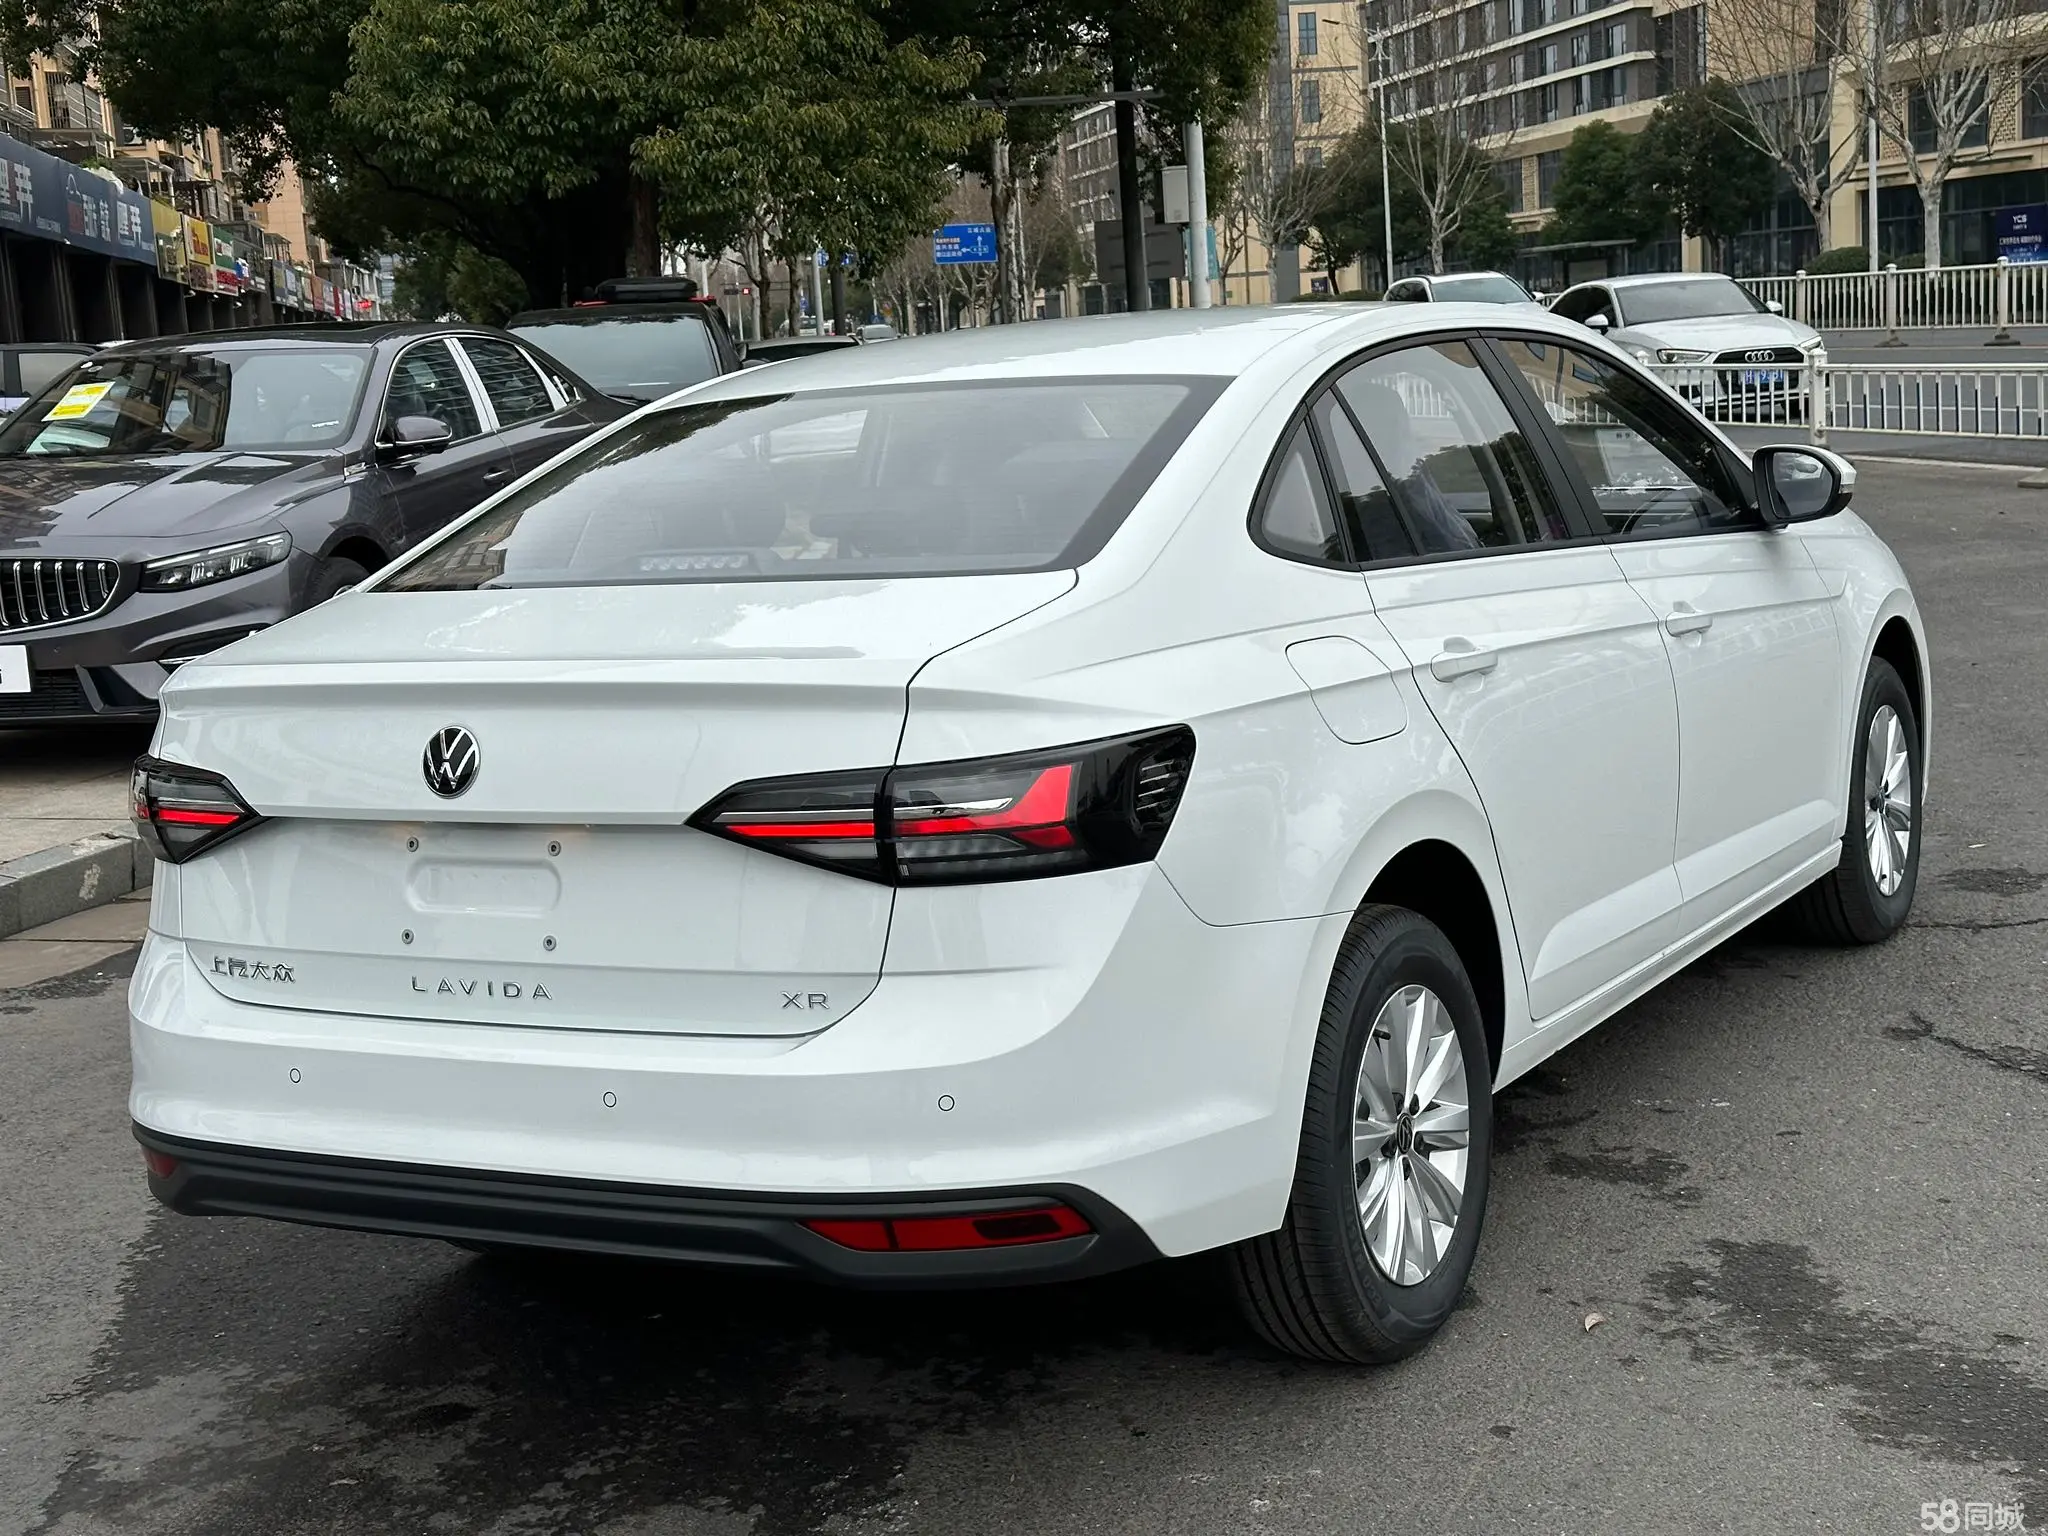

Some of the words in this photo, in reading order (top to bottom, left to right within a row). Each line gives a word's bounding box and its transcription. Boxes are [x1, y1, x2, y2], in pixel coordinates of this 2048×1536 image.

[210, 956, 296, 983] 上汽大众
[411, 975, 552, 1000] LAVIDA
[781, 991, 829, 1009] XR
